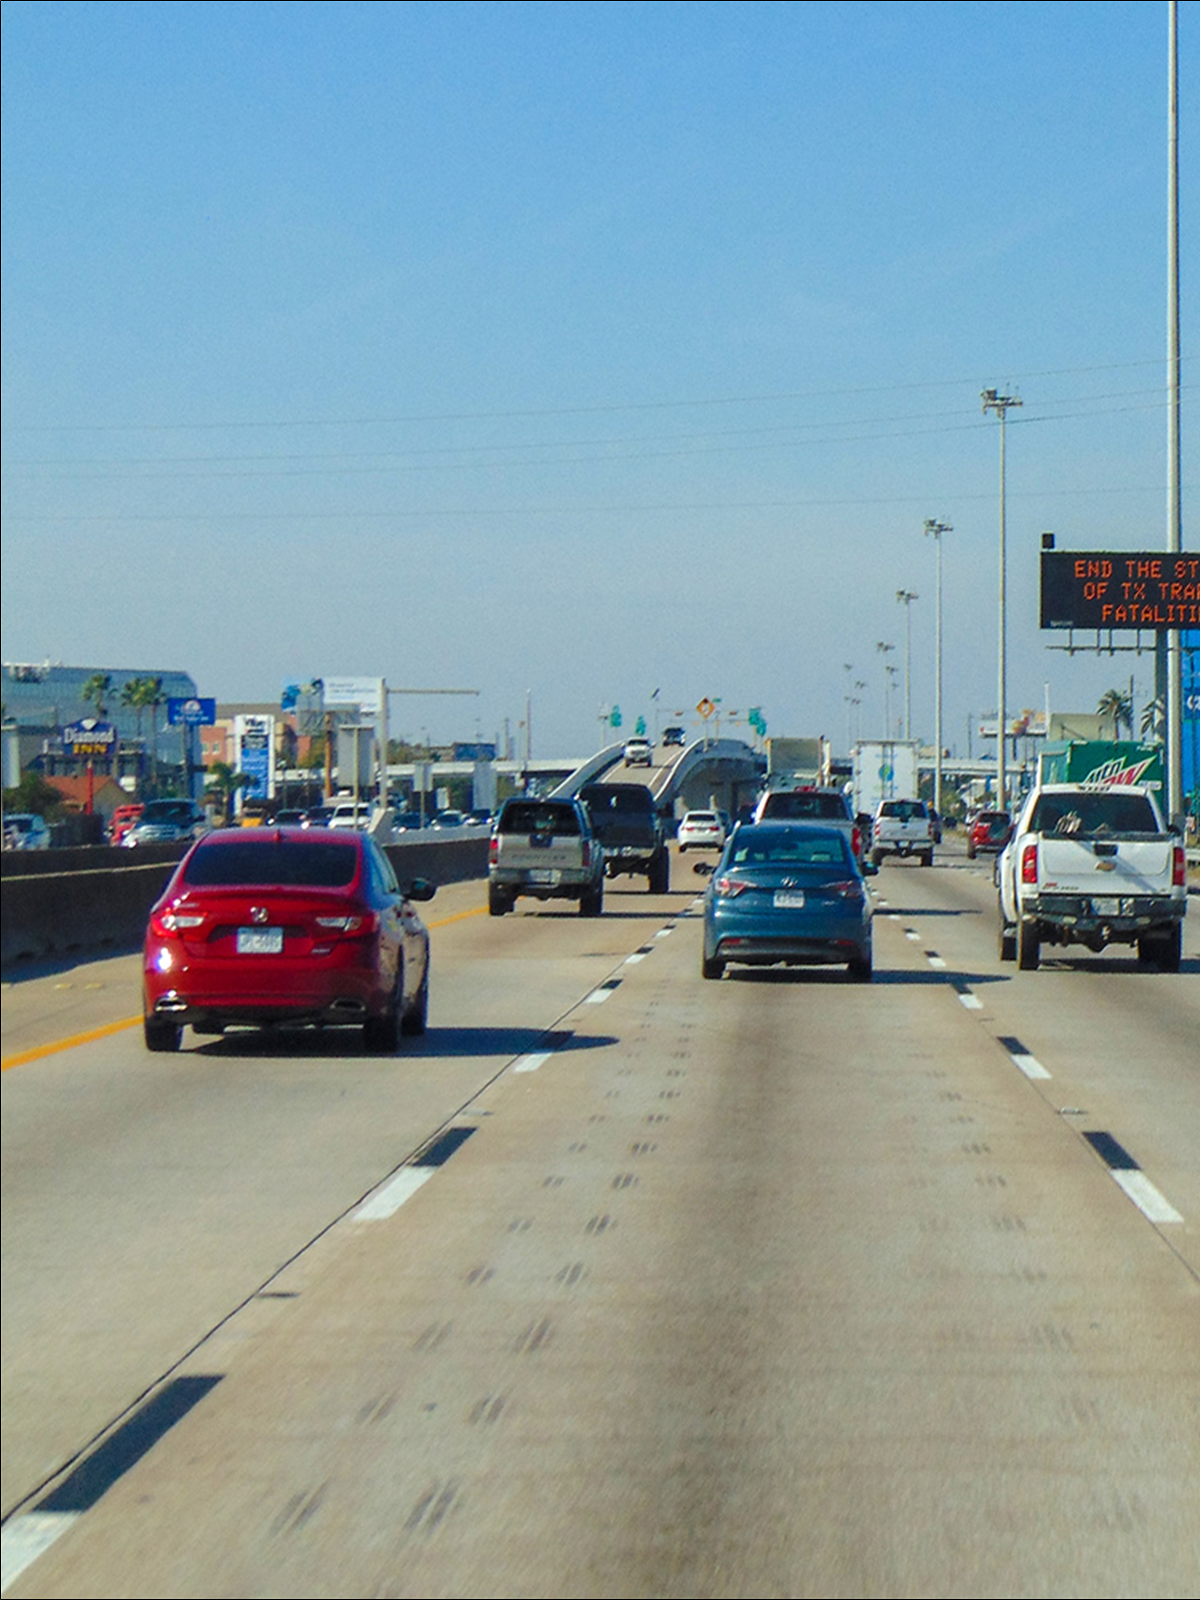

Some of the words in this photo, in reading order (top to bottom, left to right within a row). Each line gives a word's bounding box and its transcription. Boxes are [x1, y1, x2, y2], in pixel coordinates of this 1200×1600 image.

[1074, 560, 1112, 578] END
[1126, 560, 1162, 578] THE
[1084, 582, 1108, 600] OF
[1122, 582, 1146, 600] TX
[64, 726, 114, 744] Diamond
